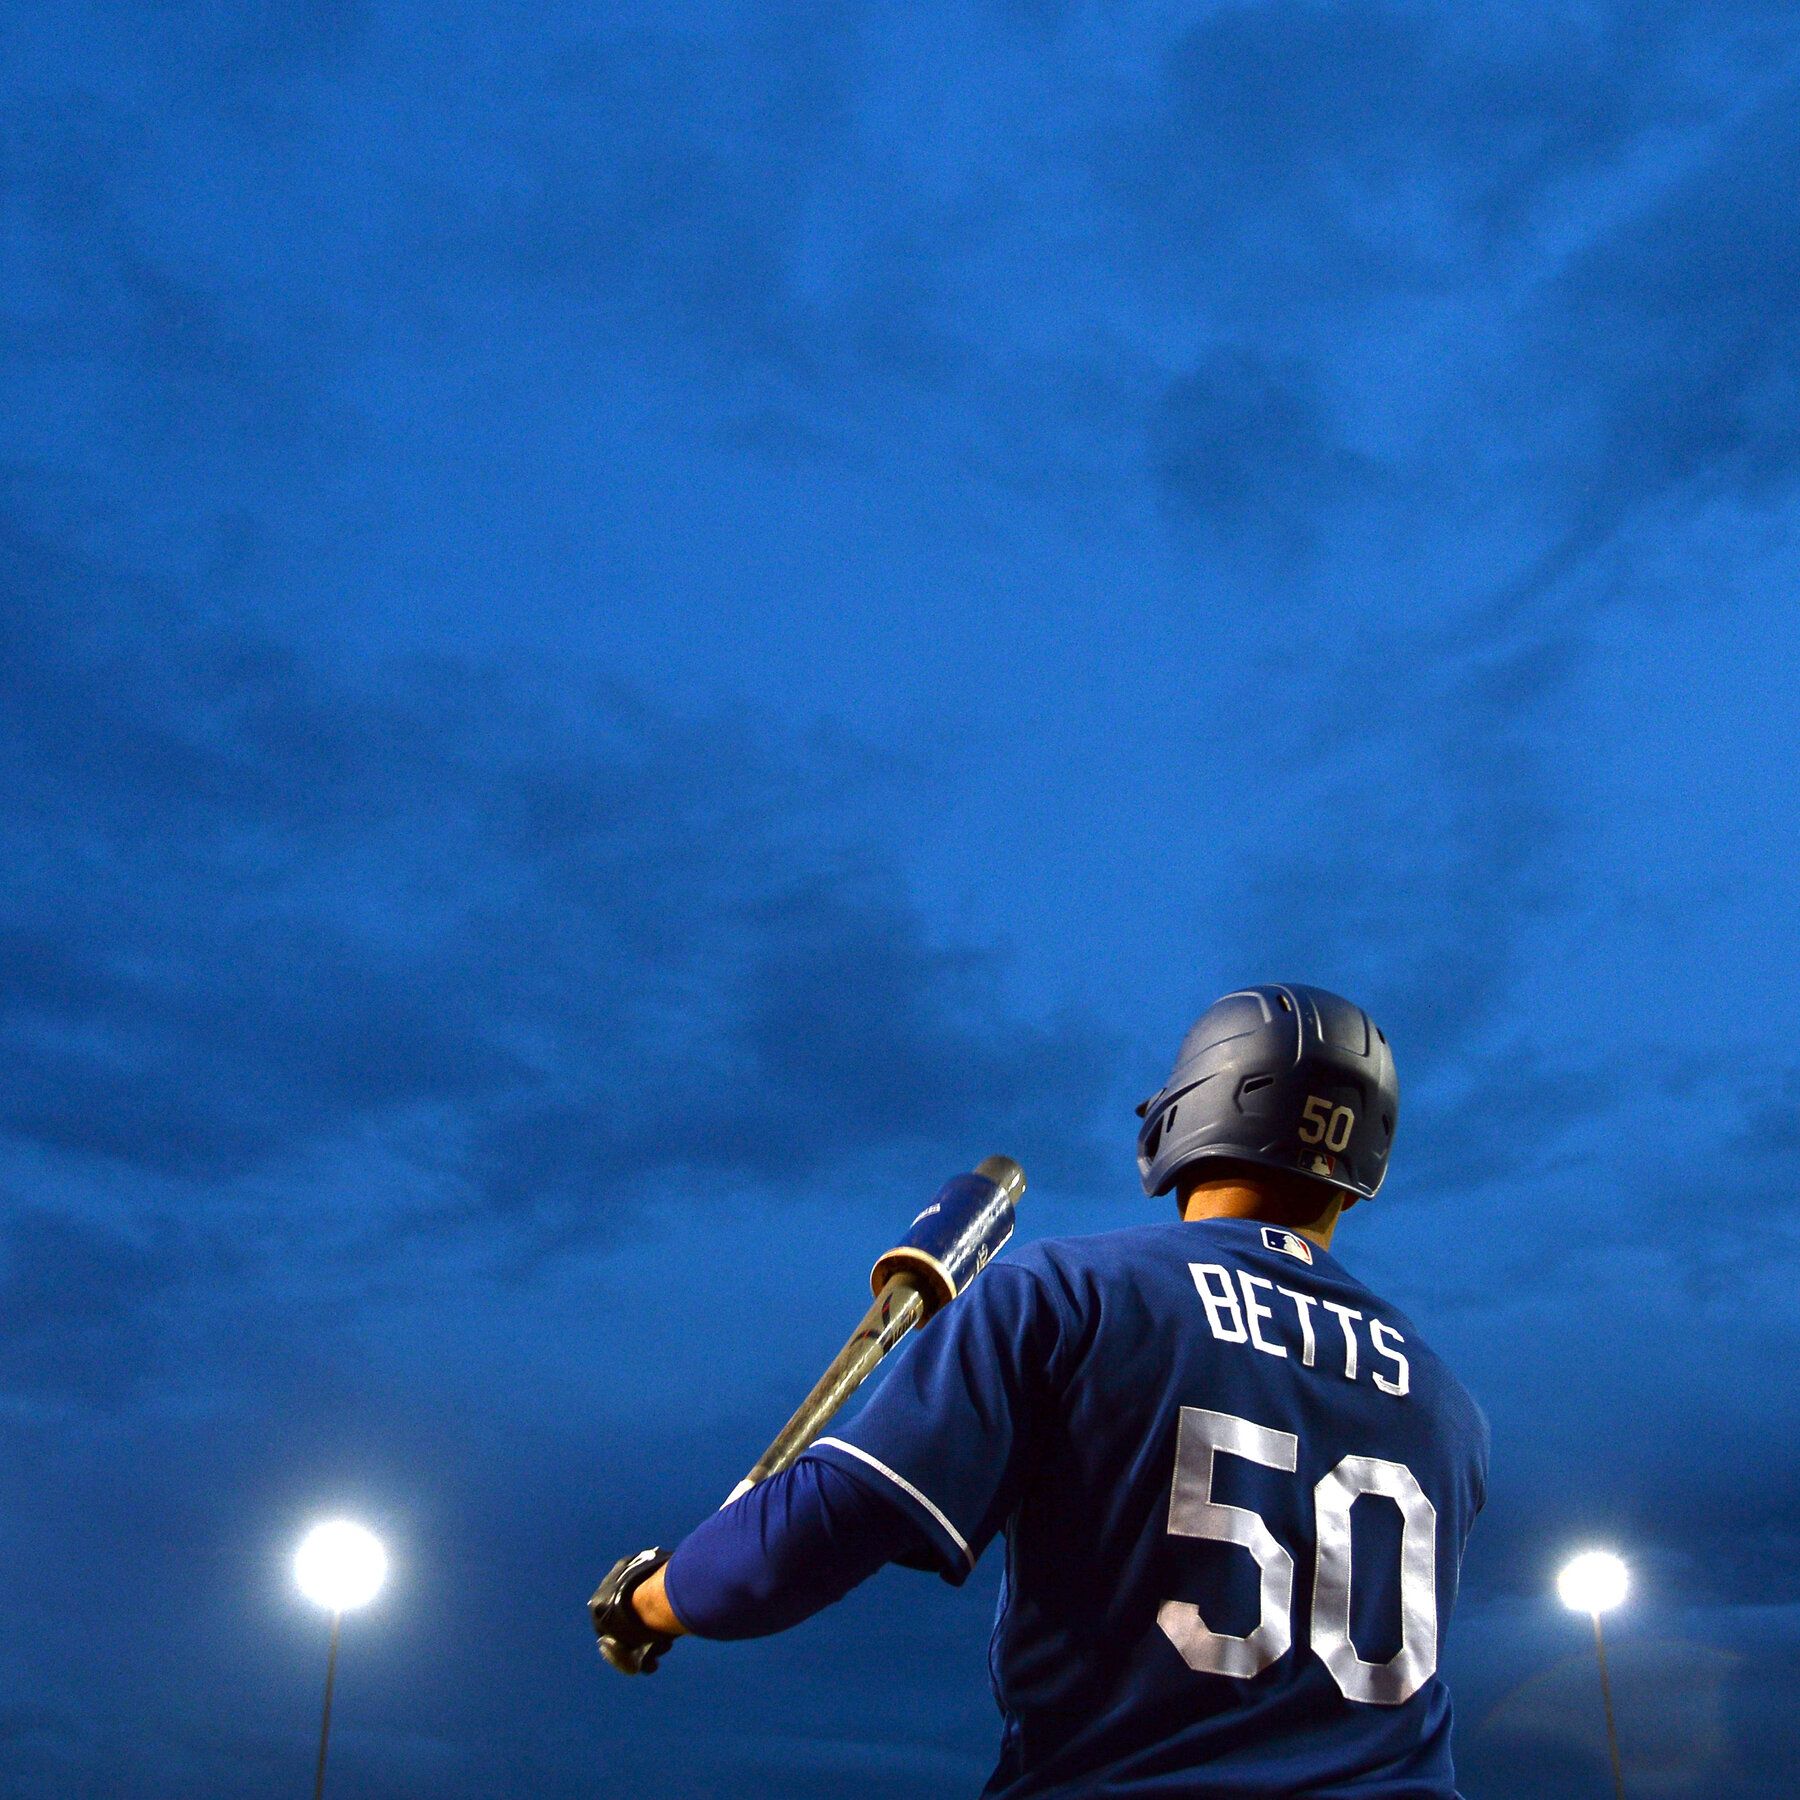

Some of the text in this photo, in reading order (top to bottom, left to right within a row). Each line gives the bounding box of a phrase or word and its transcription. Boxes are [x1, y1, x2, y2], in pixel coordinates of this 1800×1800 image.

[1298, 1095, 1355, 1153] 50
[1187, 1262, 1409, 1397] BETTS
[1157, 1406, 1437, 1705] 50
